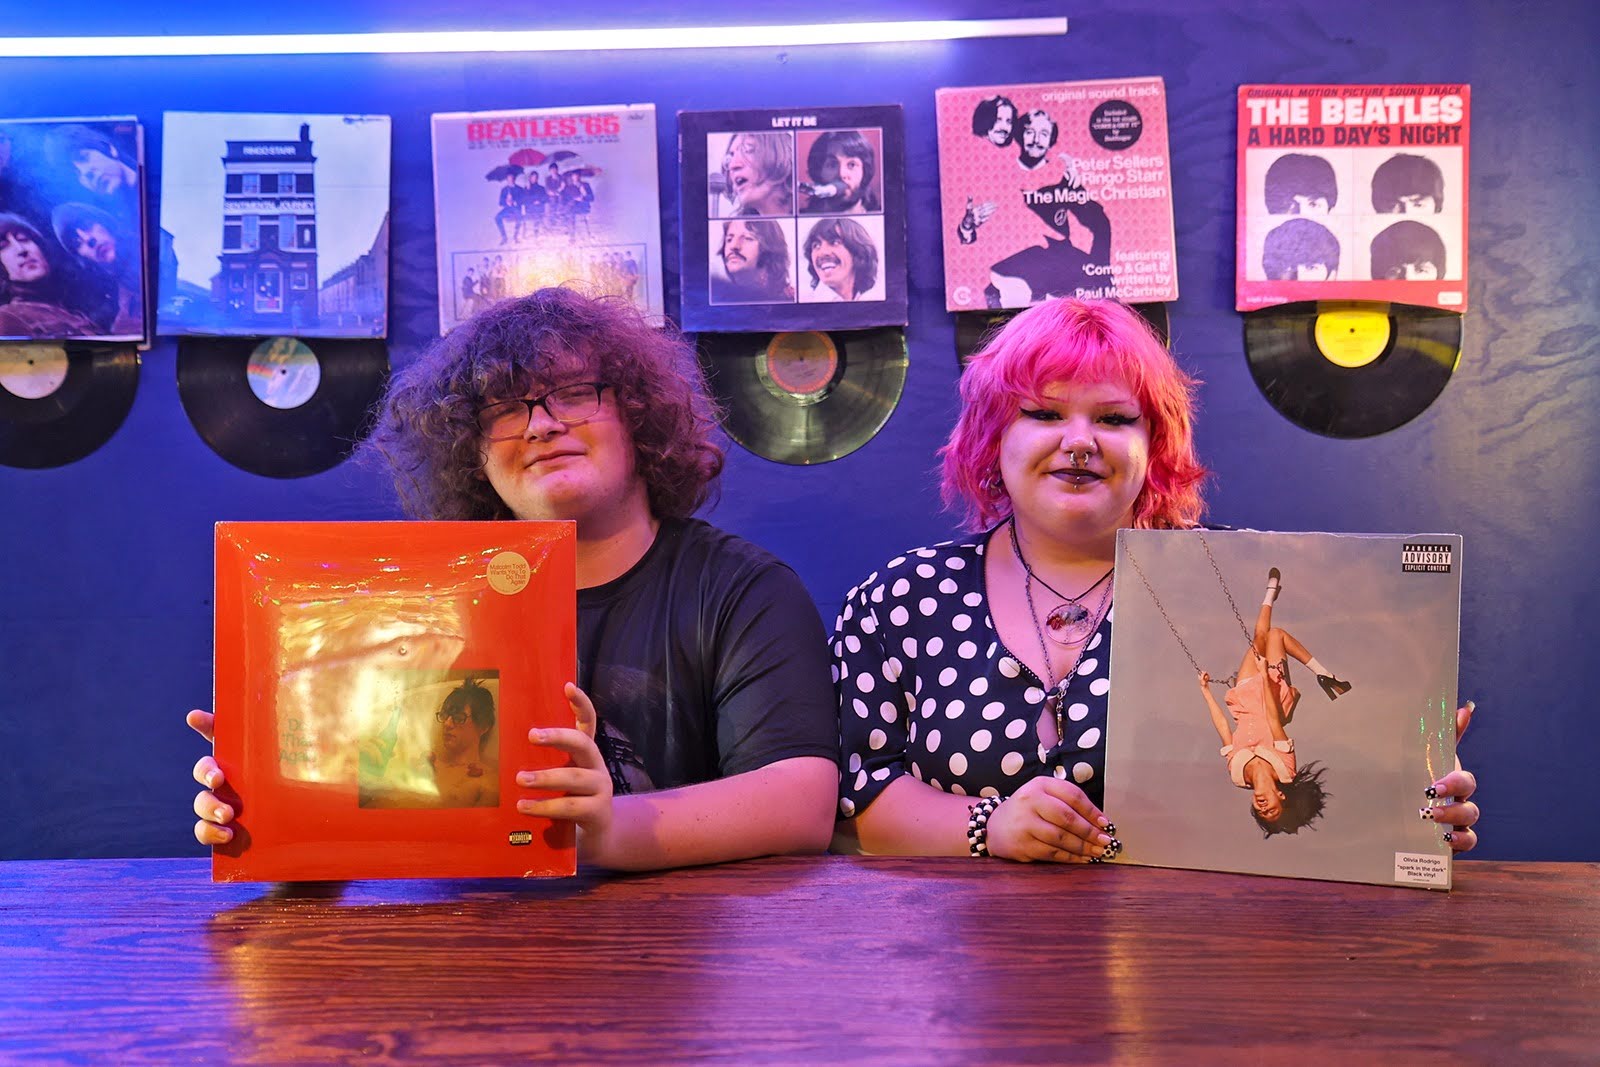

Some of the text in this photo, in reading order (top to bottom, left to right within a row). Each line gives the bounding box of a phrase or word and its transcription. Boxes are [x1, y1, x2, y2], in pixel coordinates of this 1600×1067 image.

[1041, 85, 1160, 103] original sound track
[1247, 86, 1464, 98] ORIGINAL MOTION PICTURE SOUND TRACK
[1246, 95, 1464, 126] THE BEATLES
[771, 115, 818, 127] LET IT BE
[466, 118, 577, 142] BEATLES
[1247, 125, 1463, 146] A HARD DAY'S NIGHT
[1072, 155, 1164, 172] Peter Sellers
[1081, 169, 1163, 187] Ringo Starr
[1023, 186, 1166, 205] The Magic Christian
[1115, 250, 1170, 264] featuring
[1133, 262, 1156, 274] Get
[1110, 273, 1171, 287] written by
[1075, 286, 1172, 300] Paul McCartney
[1404, 552, 1449, 563] ADVISORY
